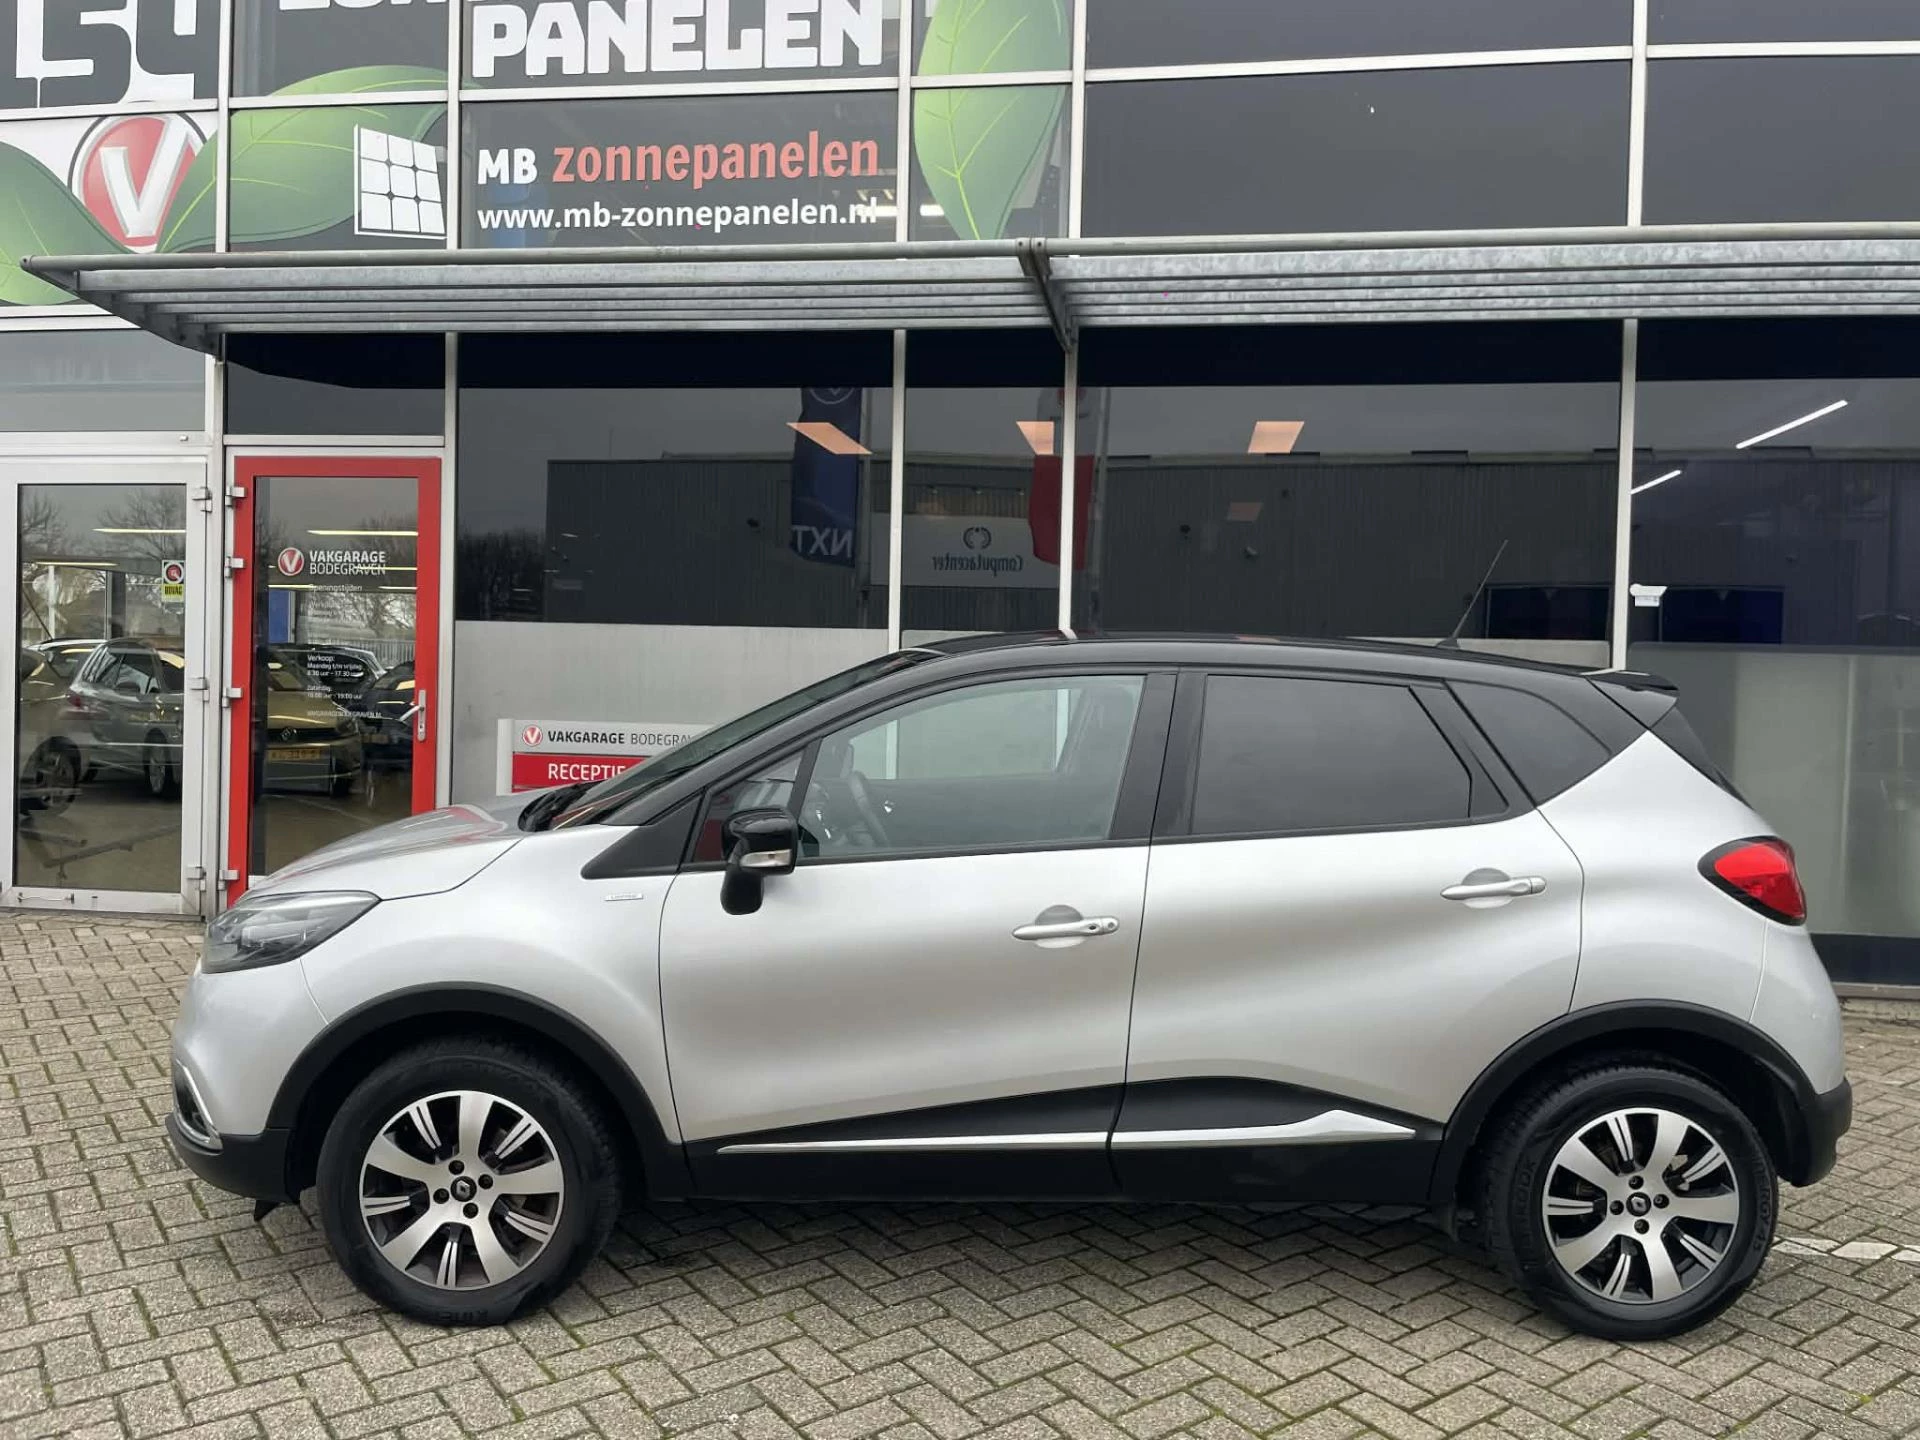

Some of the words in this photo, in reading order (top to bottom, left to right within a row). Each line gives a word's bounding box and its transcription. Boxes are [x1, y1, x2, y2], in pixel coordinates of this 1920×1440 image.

[472, 0, 883, 78] PANELEN
[477, 148, 538, 185] MB
[552, 130, 879, 190] zonnepanelen
[477, 197, 878, 233] www.mb-zonnepanelen.nl
[309, 550, 387, 563] VAKGARAGE
[309, 563, 386, 575] BODEGRAVEN
[547, 731, 625, 745] VAKGARAGE
